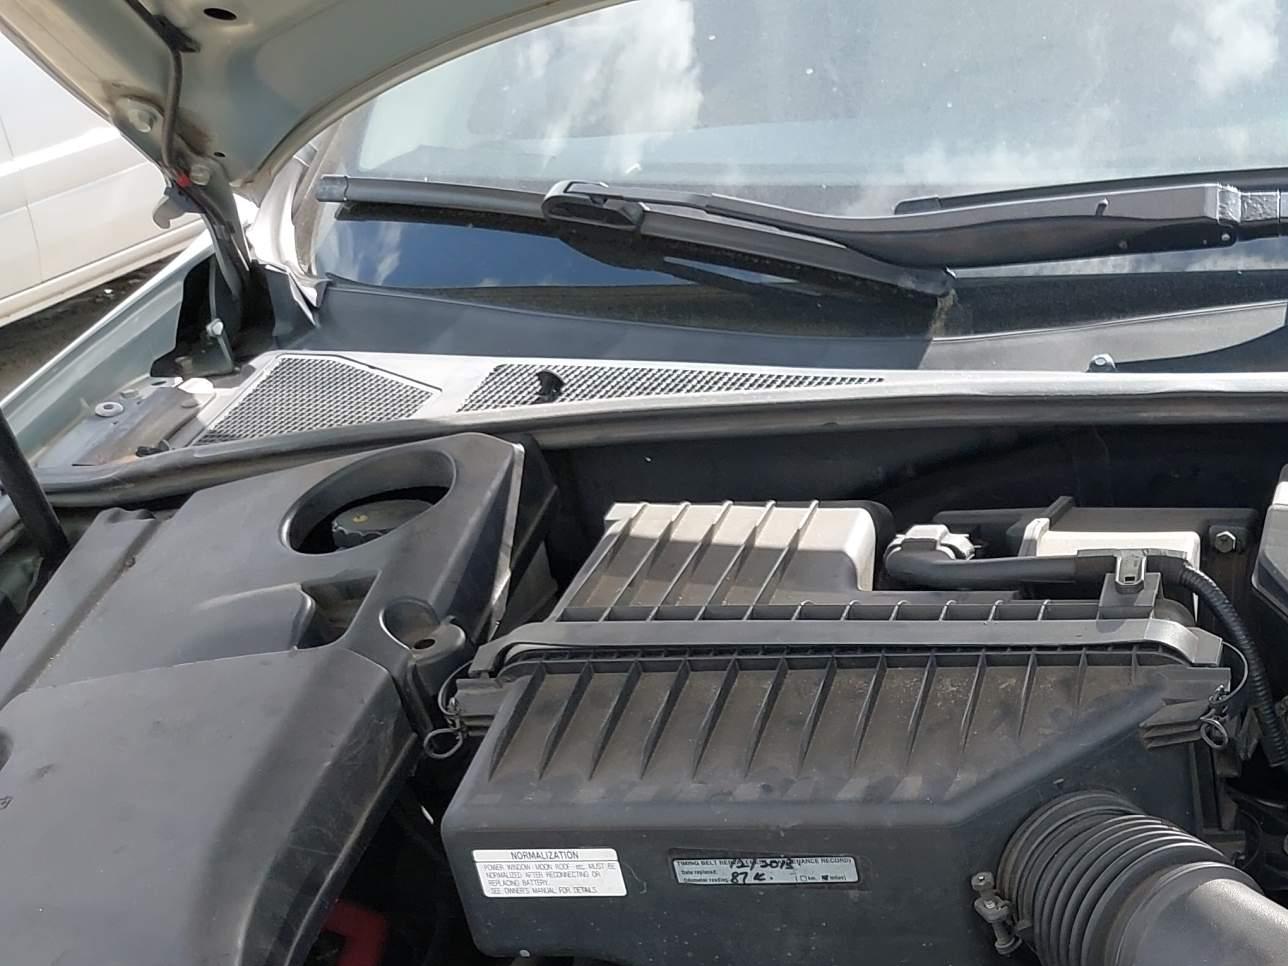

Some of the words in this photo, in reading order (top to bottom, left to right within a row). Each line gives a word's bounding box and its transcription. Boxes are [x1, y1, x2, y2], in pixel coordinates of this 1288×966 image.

[510, 850, 579, 860] NORMALIZATION
[483, 863, 504, 871] POWER
[486, 871, 522, 879] NORMALIZED
[525, 871, 543, 879] AFTER
[546, 870, 589, 878] RECONNECTING
[592, 870, 601, 878] OR
[731, 871, 748, 884] 87
[488, 879, 520, 887] REPLACING
[490, 887, 502, 895] SEE
[532, 887, 557, 895] MANUAL
